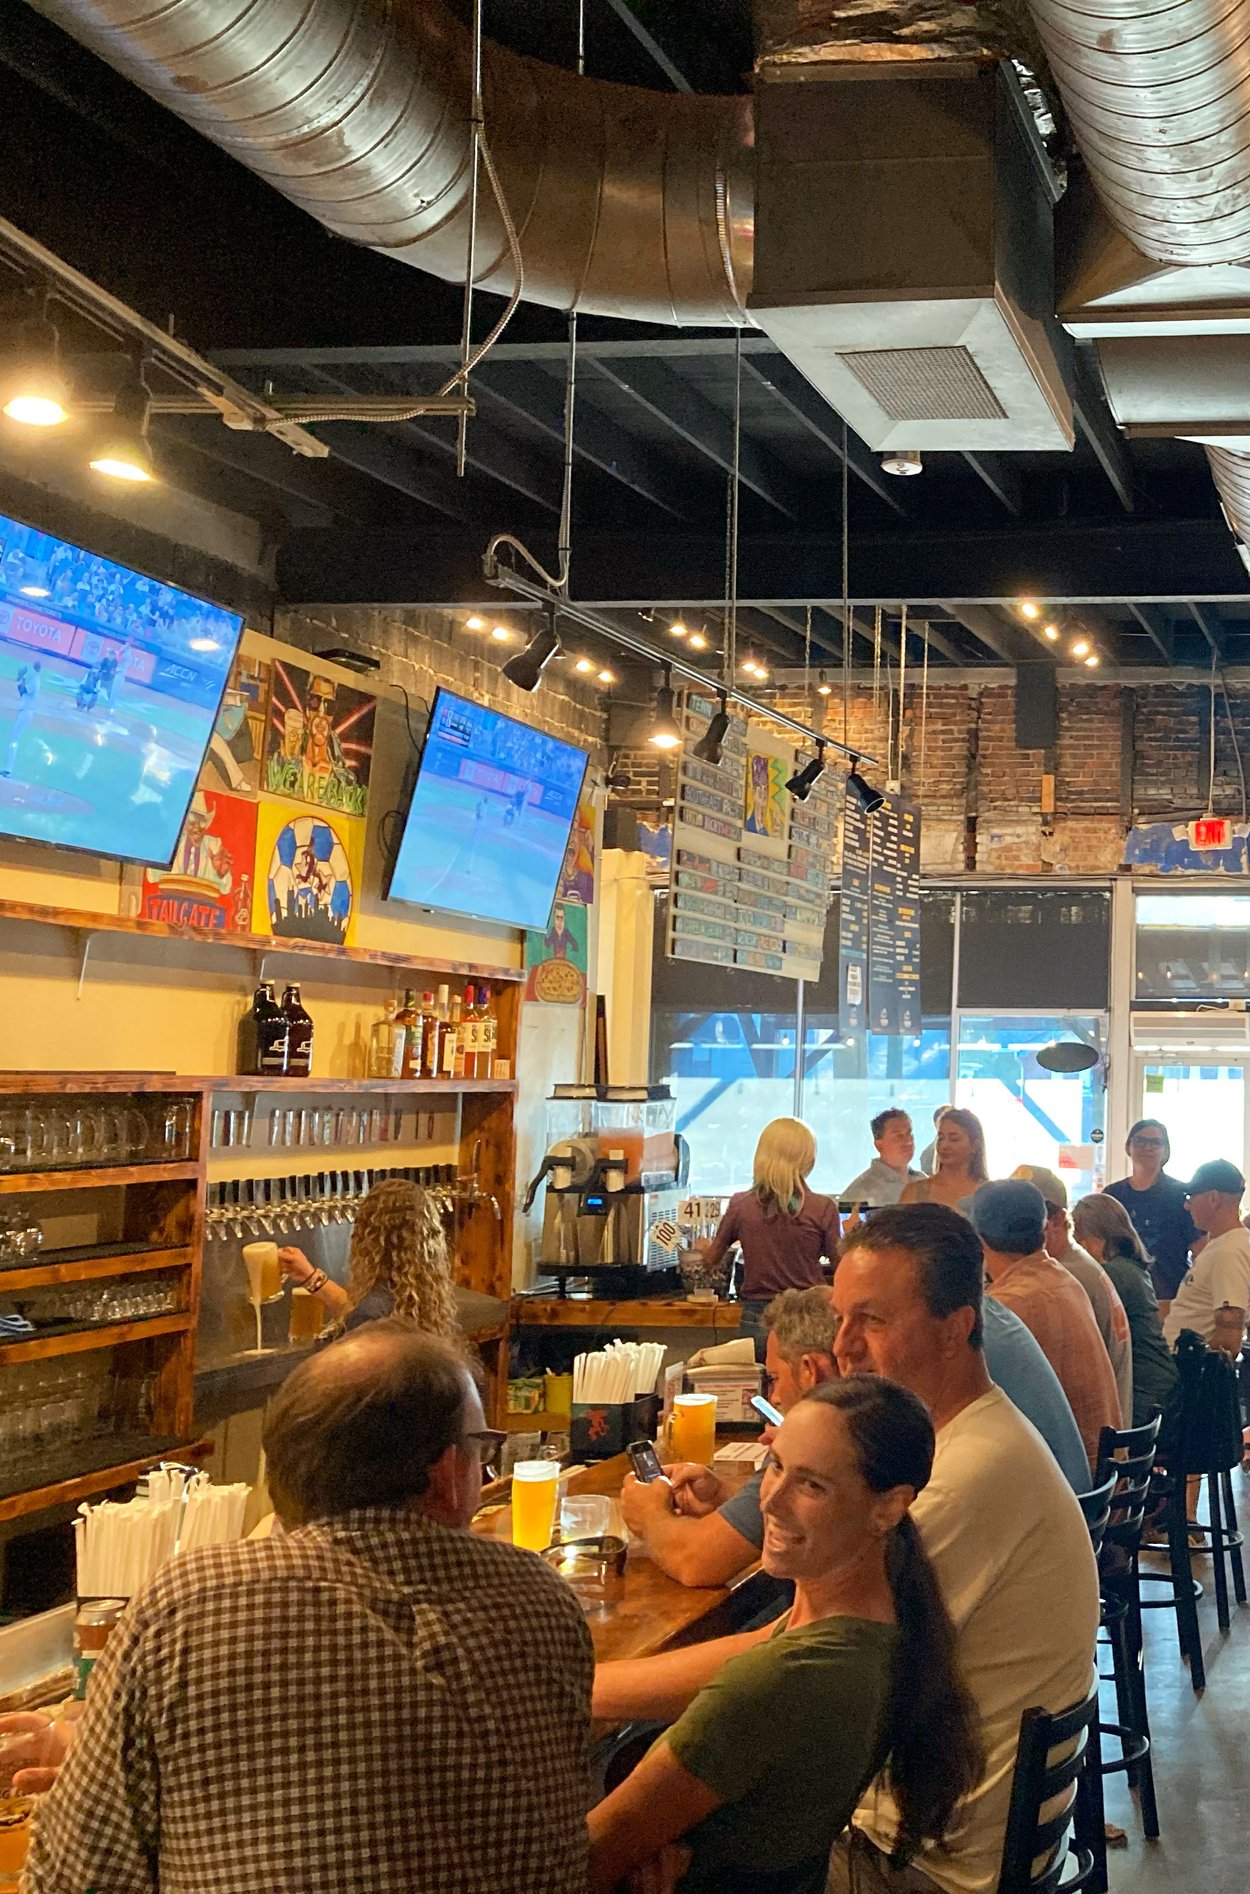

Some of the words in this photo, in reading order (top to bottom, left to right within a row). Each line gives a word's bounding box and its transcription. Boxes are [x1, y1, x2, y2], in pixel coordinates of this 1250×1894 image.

[17, 616, 62, 642] TOYOTA
[149, 898, 220, 929] TAILGATE
[684, 1202, 701, 1218] 41
[656, 1222, 676, 1246] 100
